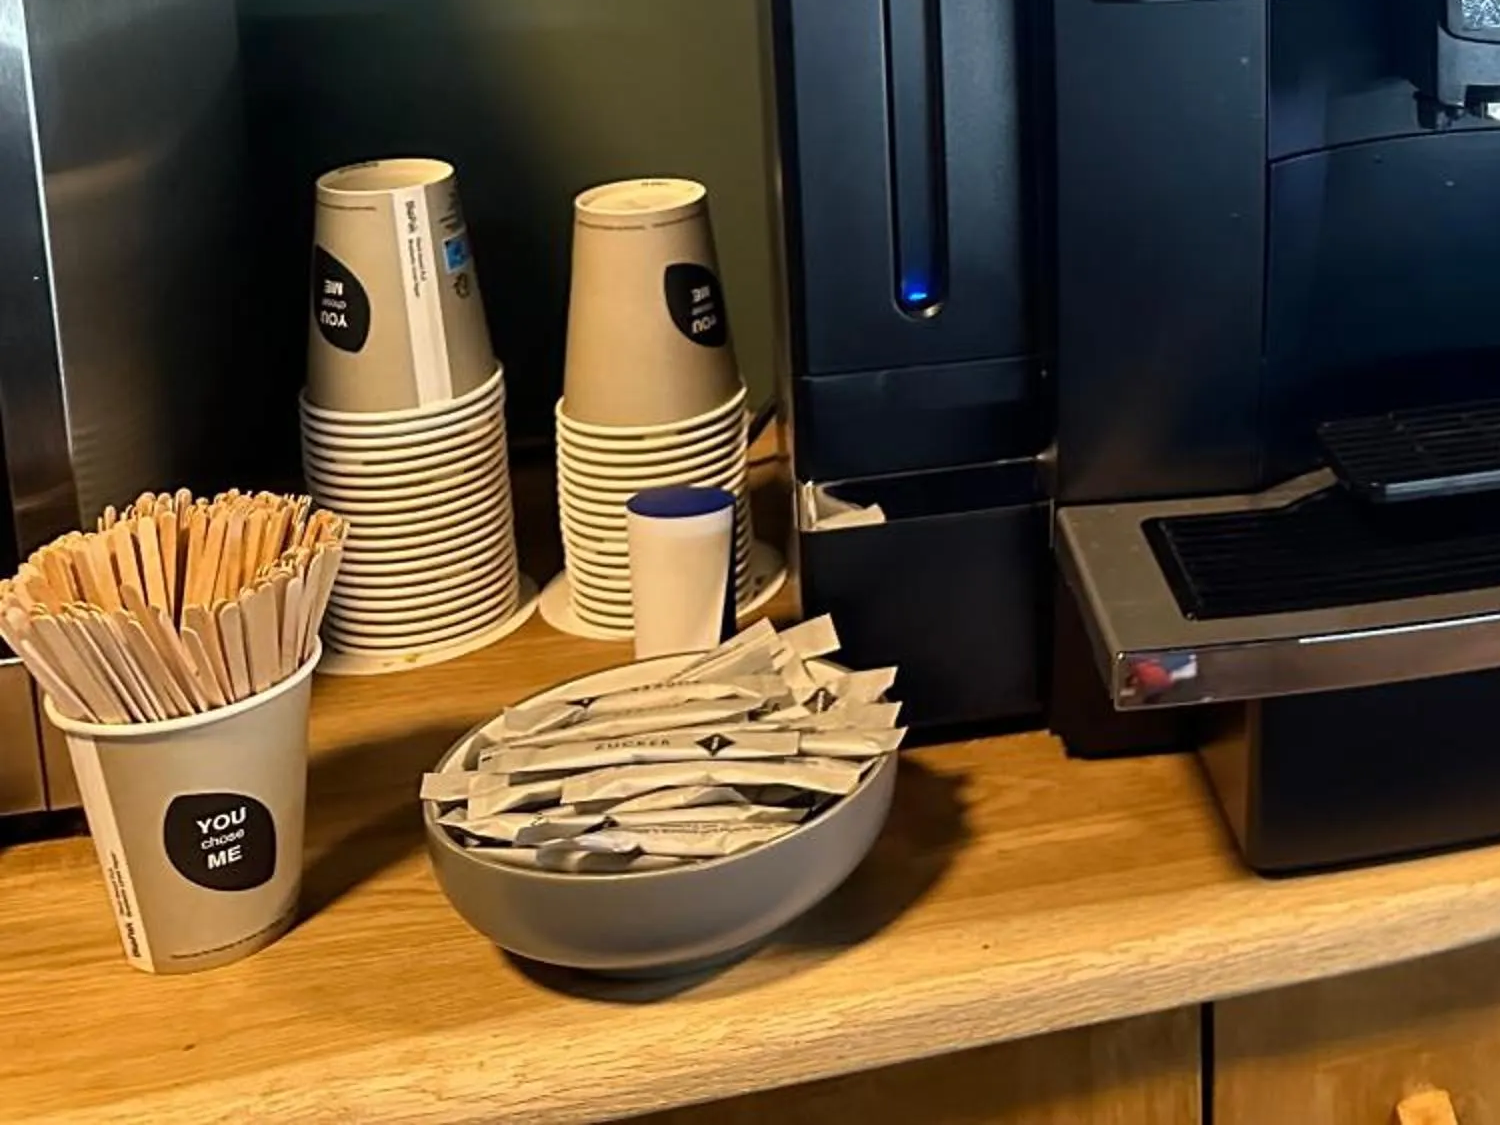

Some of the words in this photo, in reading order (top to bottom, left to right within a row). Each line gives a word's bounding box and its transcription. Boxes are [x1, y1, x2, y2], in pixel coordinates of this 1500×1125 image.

[323, 279, 344, 296] ME
[320, 310, 348, 329] YOU
[196, 806, 248, 835] YOU
[200, 827, 246, 852] chose
[206, 845, 243, 871] ME
